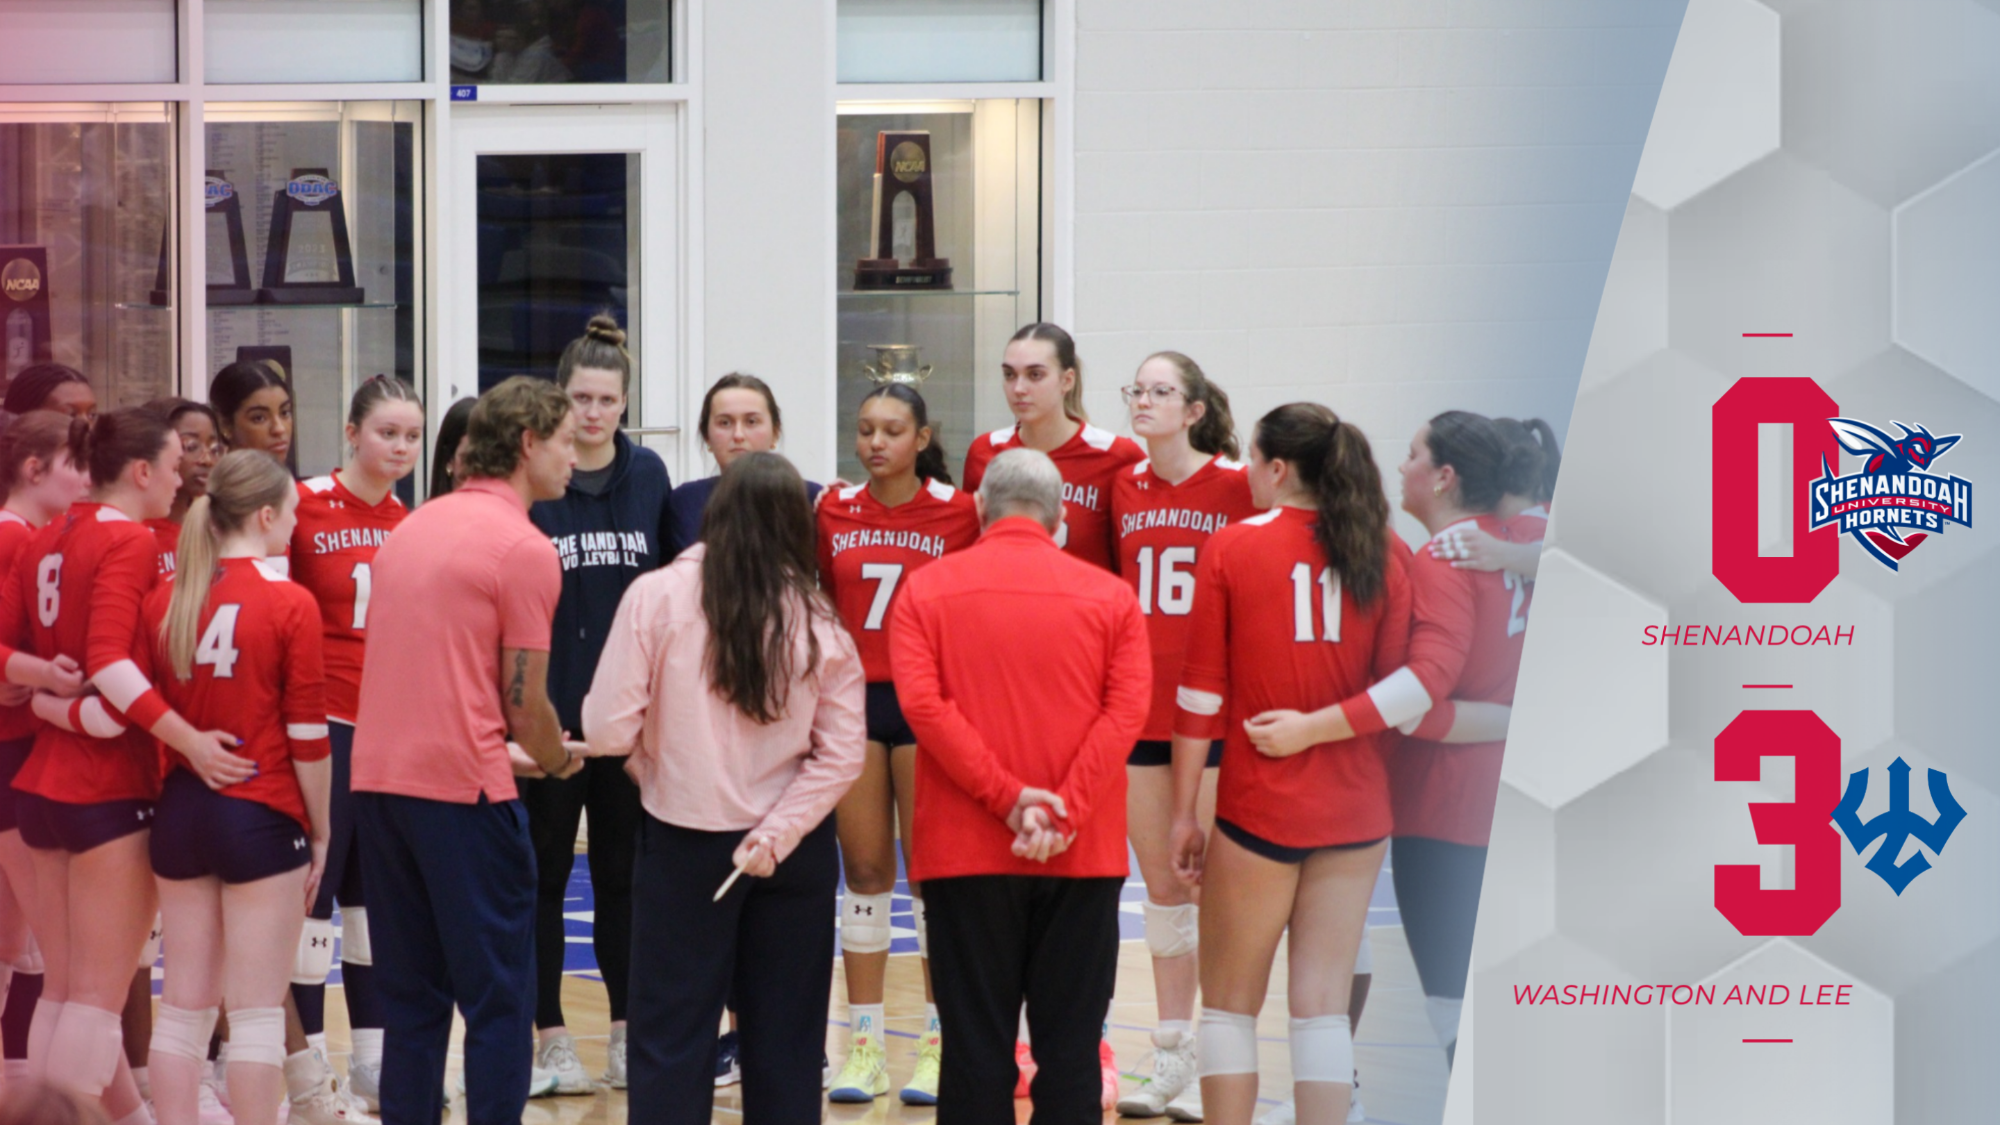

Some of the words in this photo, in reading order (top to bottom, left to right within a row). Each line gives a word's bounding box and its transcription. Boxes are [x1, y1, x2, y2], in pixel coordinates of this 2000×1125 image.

[456, 88, 471, 98] 407
[894, 161, 925, 173] NCAA
[288, 181, 338, 196] ODAC
[6, 278, 39, 291] NCAA
[1121, 508, 1228, 539] SHENANDOAH
[831, 528, 945, 559] SHENANDOAH
[37, 552, 63, 628] 8
[1137, 546, 1196, 615] 16
[861, 563, 904, 630] 7
[1290, 561, 1342, 643] 11
[195, 603, 241, 678] 4
